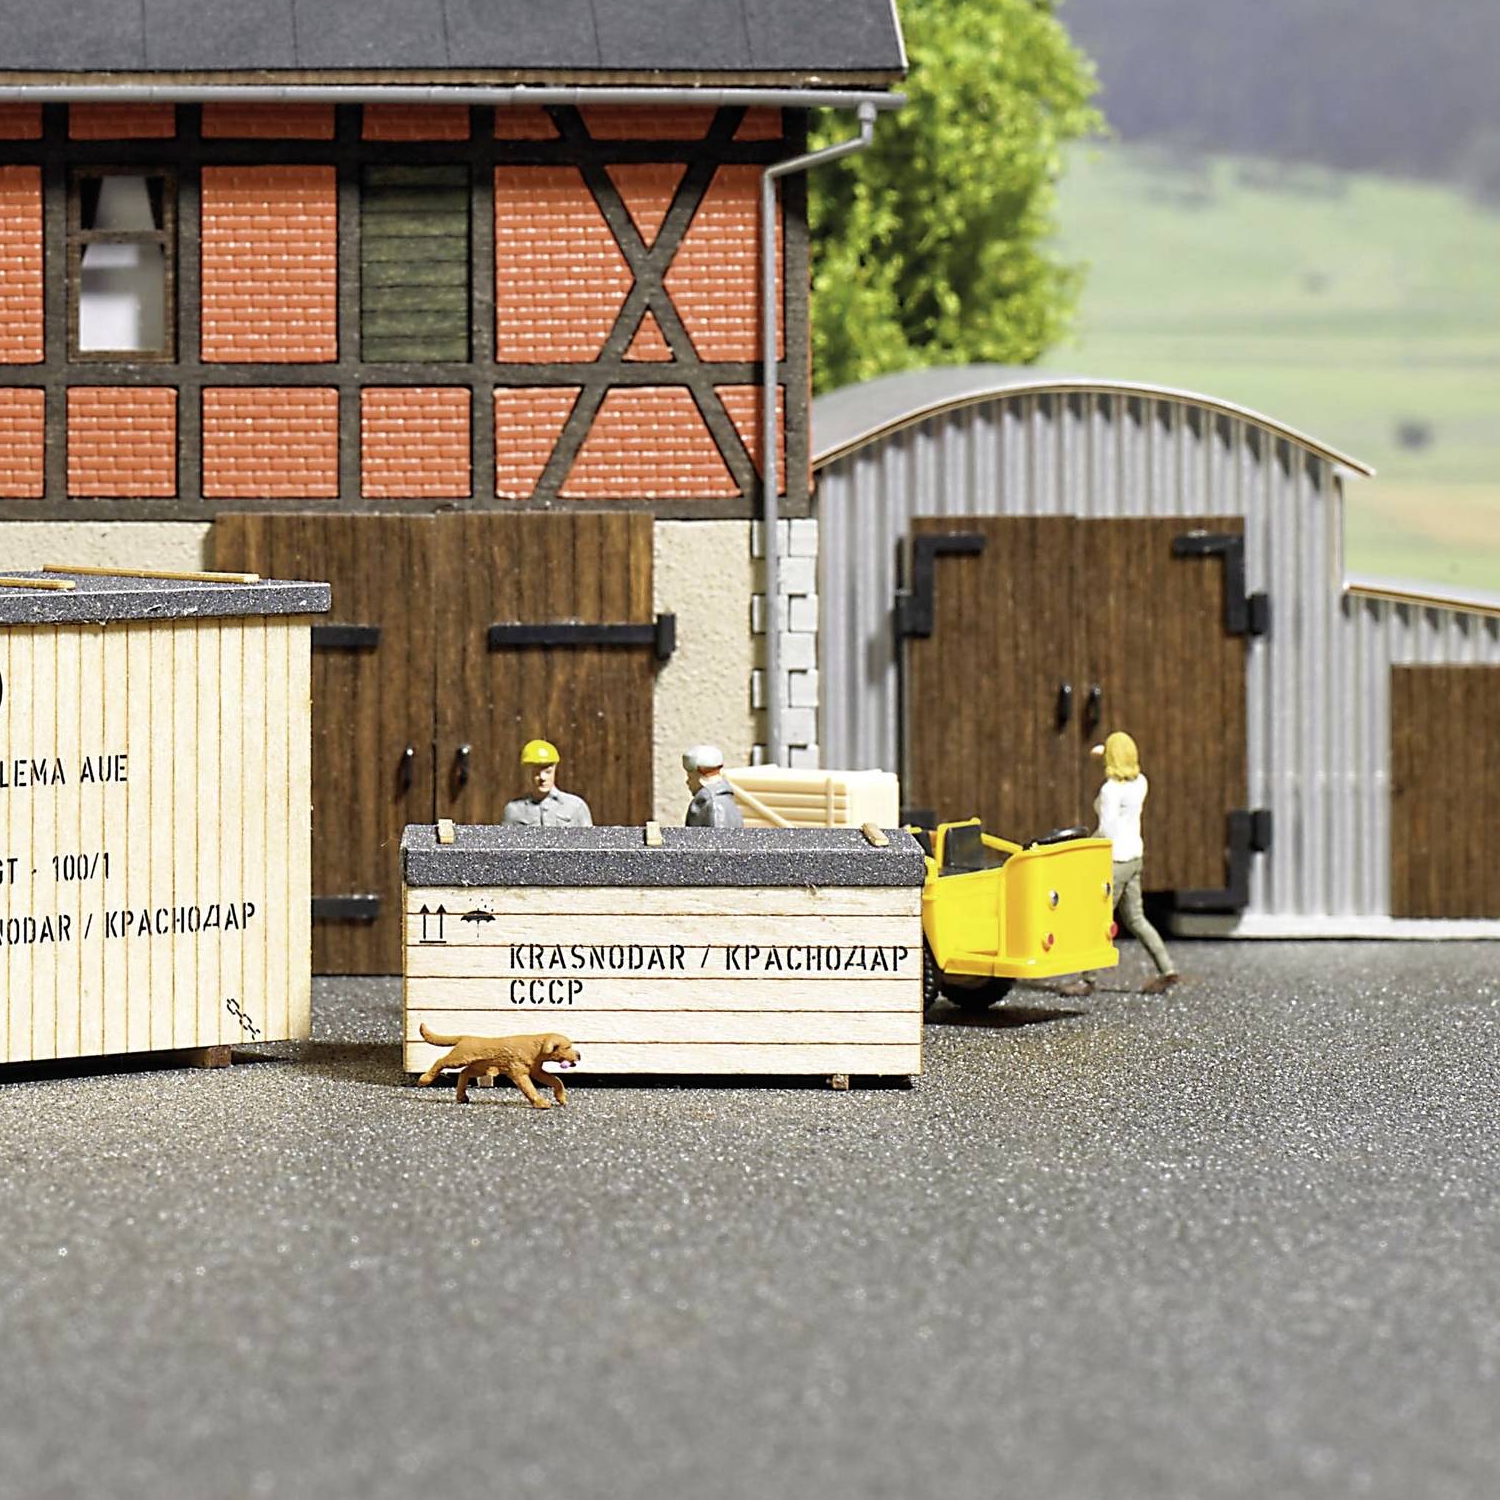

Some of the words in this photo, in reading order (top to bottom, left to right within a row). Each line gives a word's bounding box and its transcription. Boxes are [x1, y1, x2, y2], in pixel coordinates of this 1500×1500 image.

[81, 755, 127, 782] AUE
[53, 853, 108, 881] 100/1
[85, 914, 92, 938] /
[510, 944, 686, 970] KRASNODAR
[700, 945, 710, 968] /
